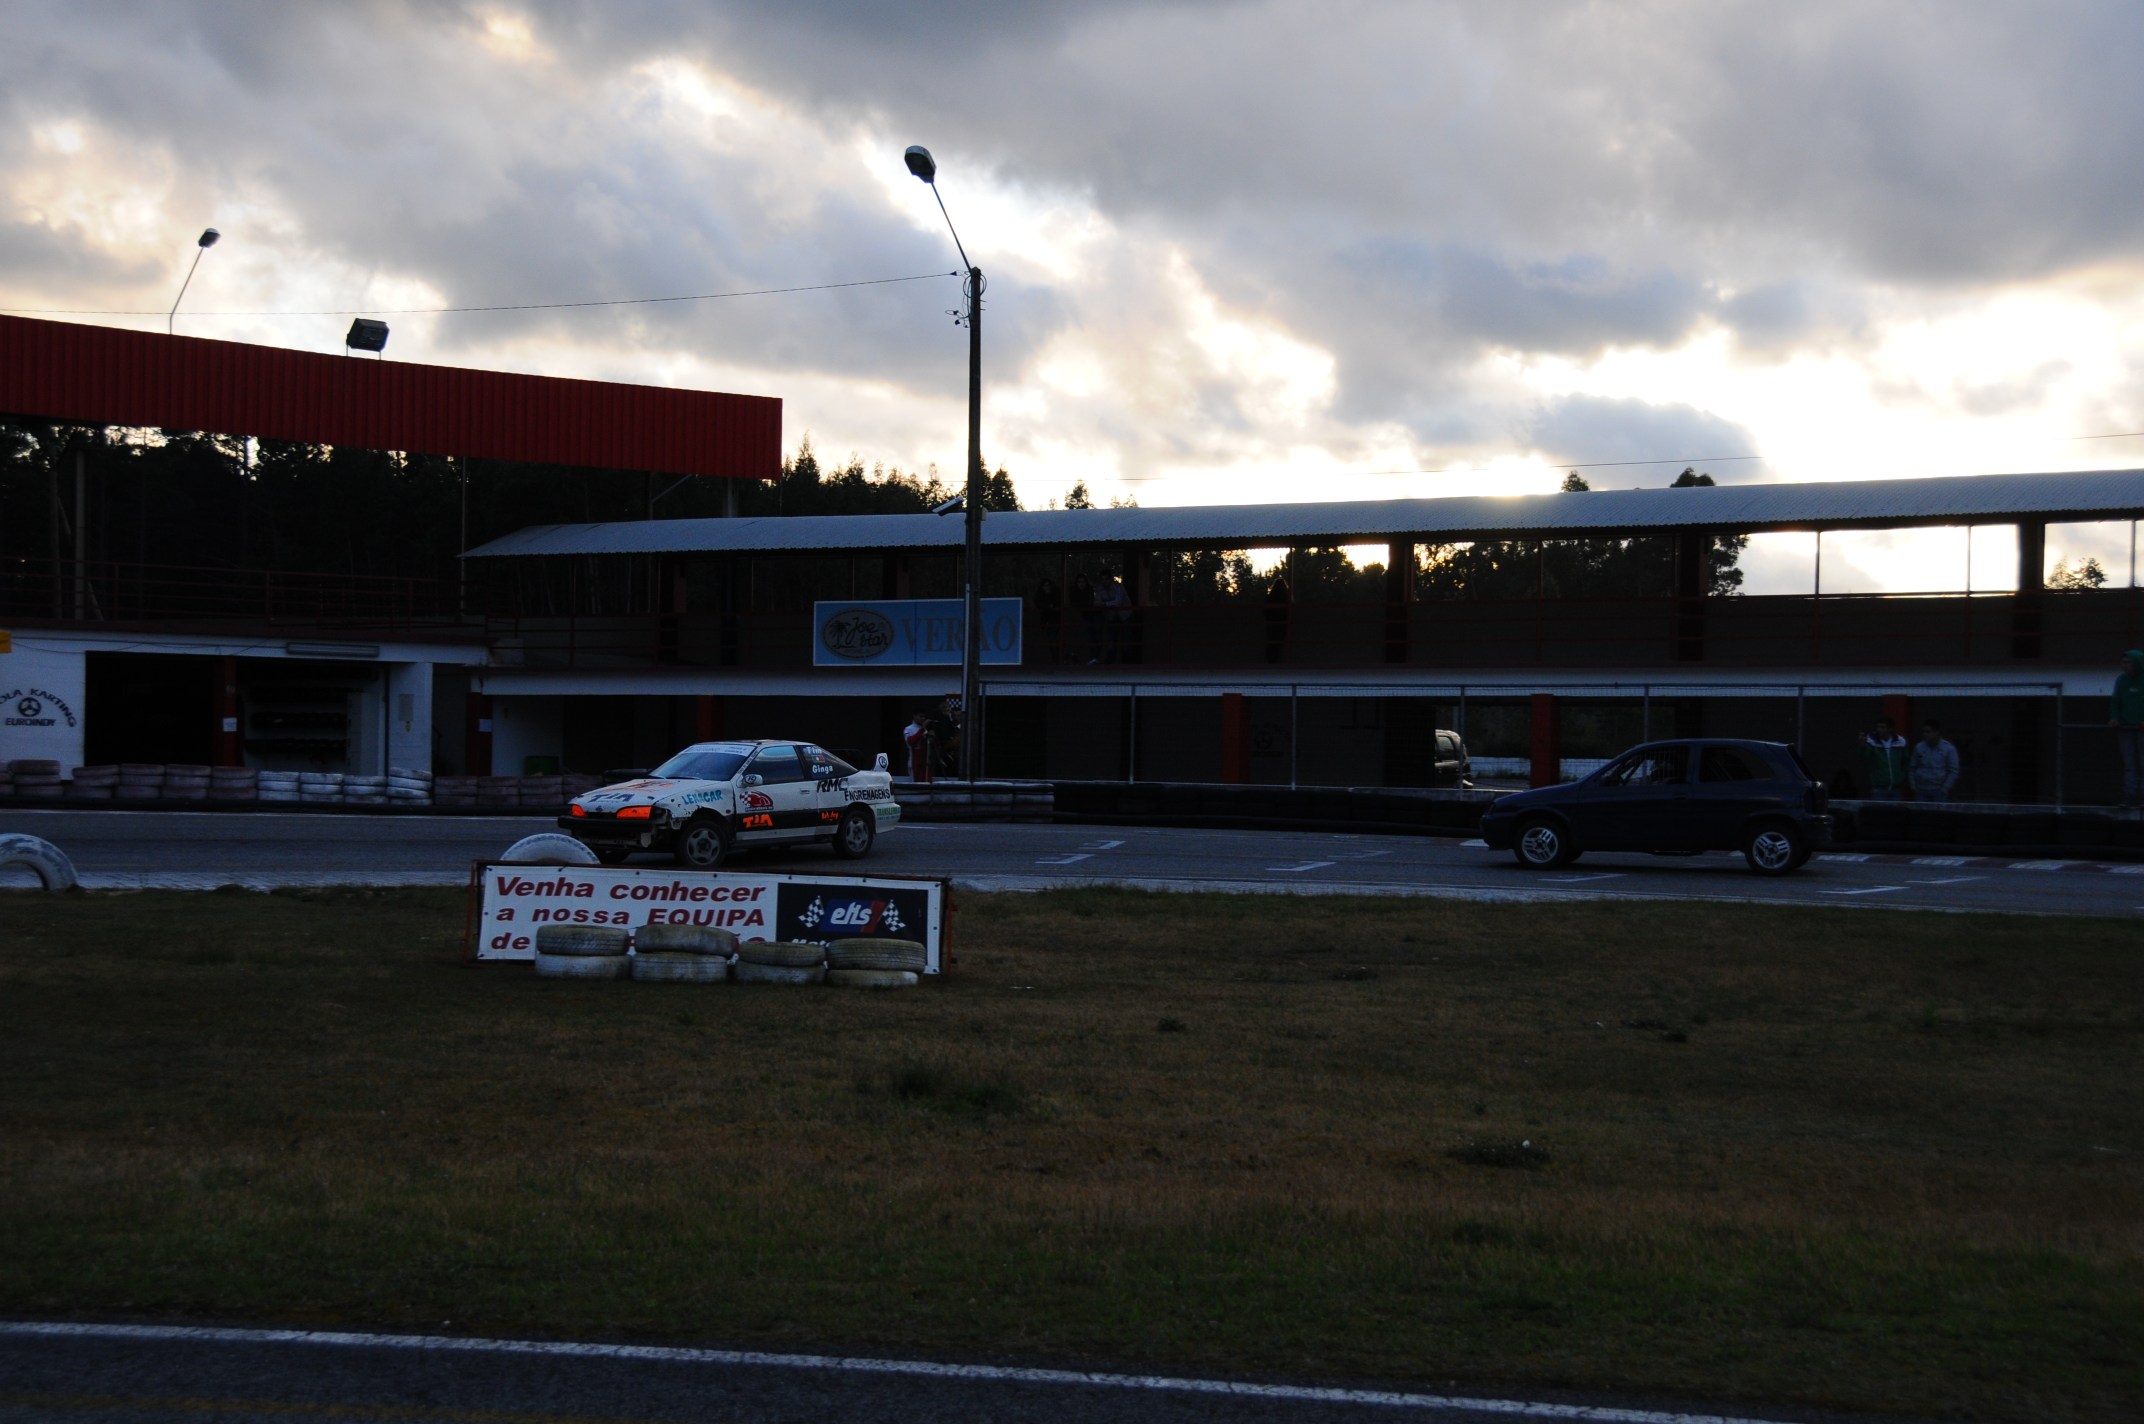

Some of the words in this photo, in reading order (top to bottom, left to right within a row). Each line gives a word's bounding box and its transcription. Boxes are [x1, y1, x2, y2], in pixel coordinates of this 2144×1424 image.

[30, 688, 77, 727] KARTING
[5, 717, 57, 727] EUROINDY
[812, 764, 834, 775] Ginga
[817, 778, 848, 793] RMC
[844, 788, 891, 802] ENGRENAGENS
[496, 876, 595, 898] Venha
[609, 880, 767, 902] conhecer
[496, 907, 515, 921] a
[531, 907, 630, 925] nossa
[646, 908, 765, 928] EQUIPA
[491, 932, 531, 950] de
